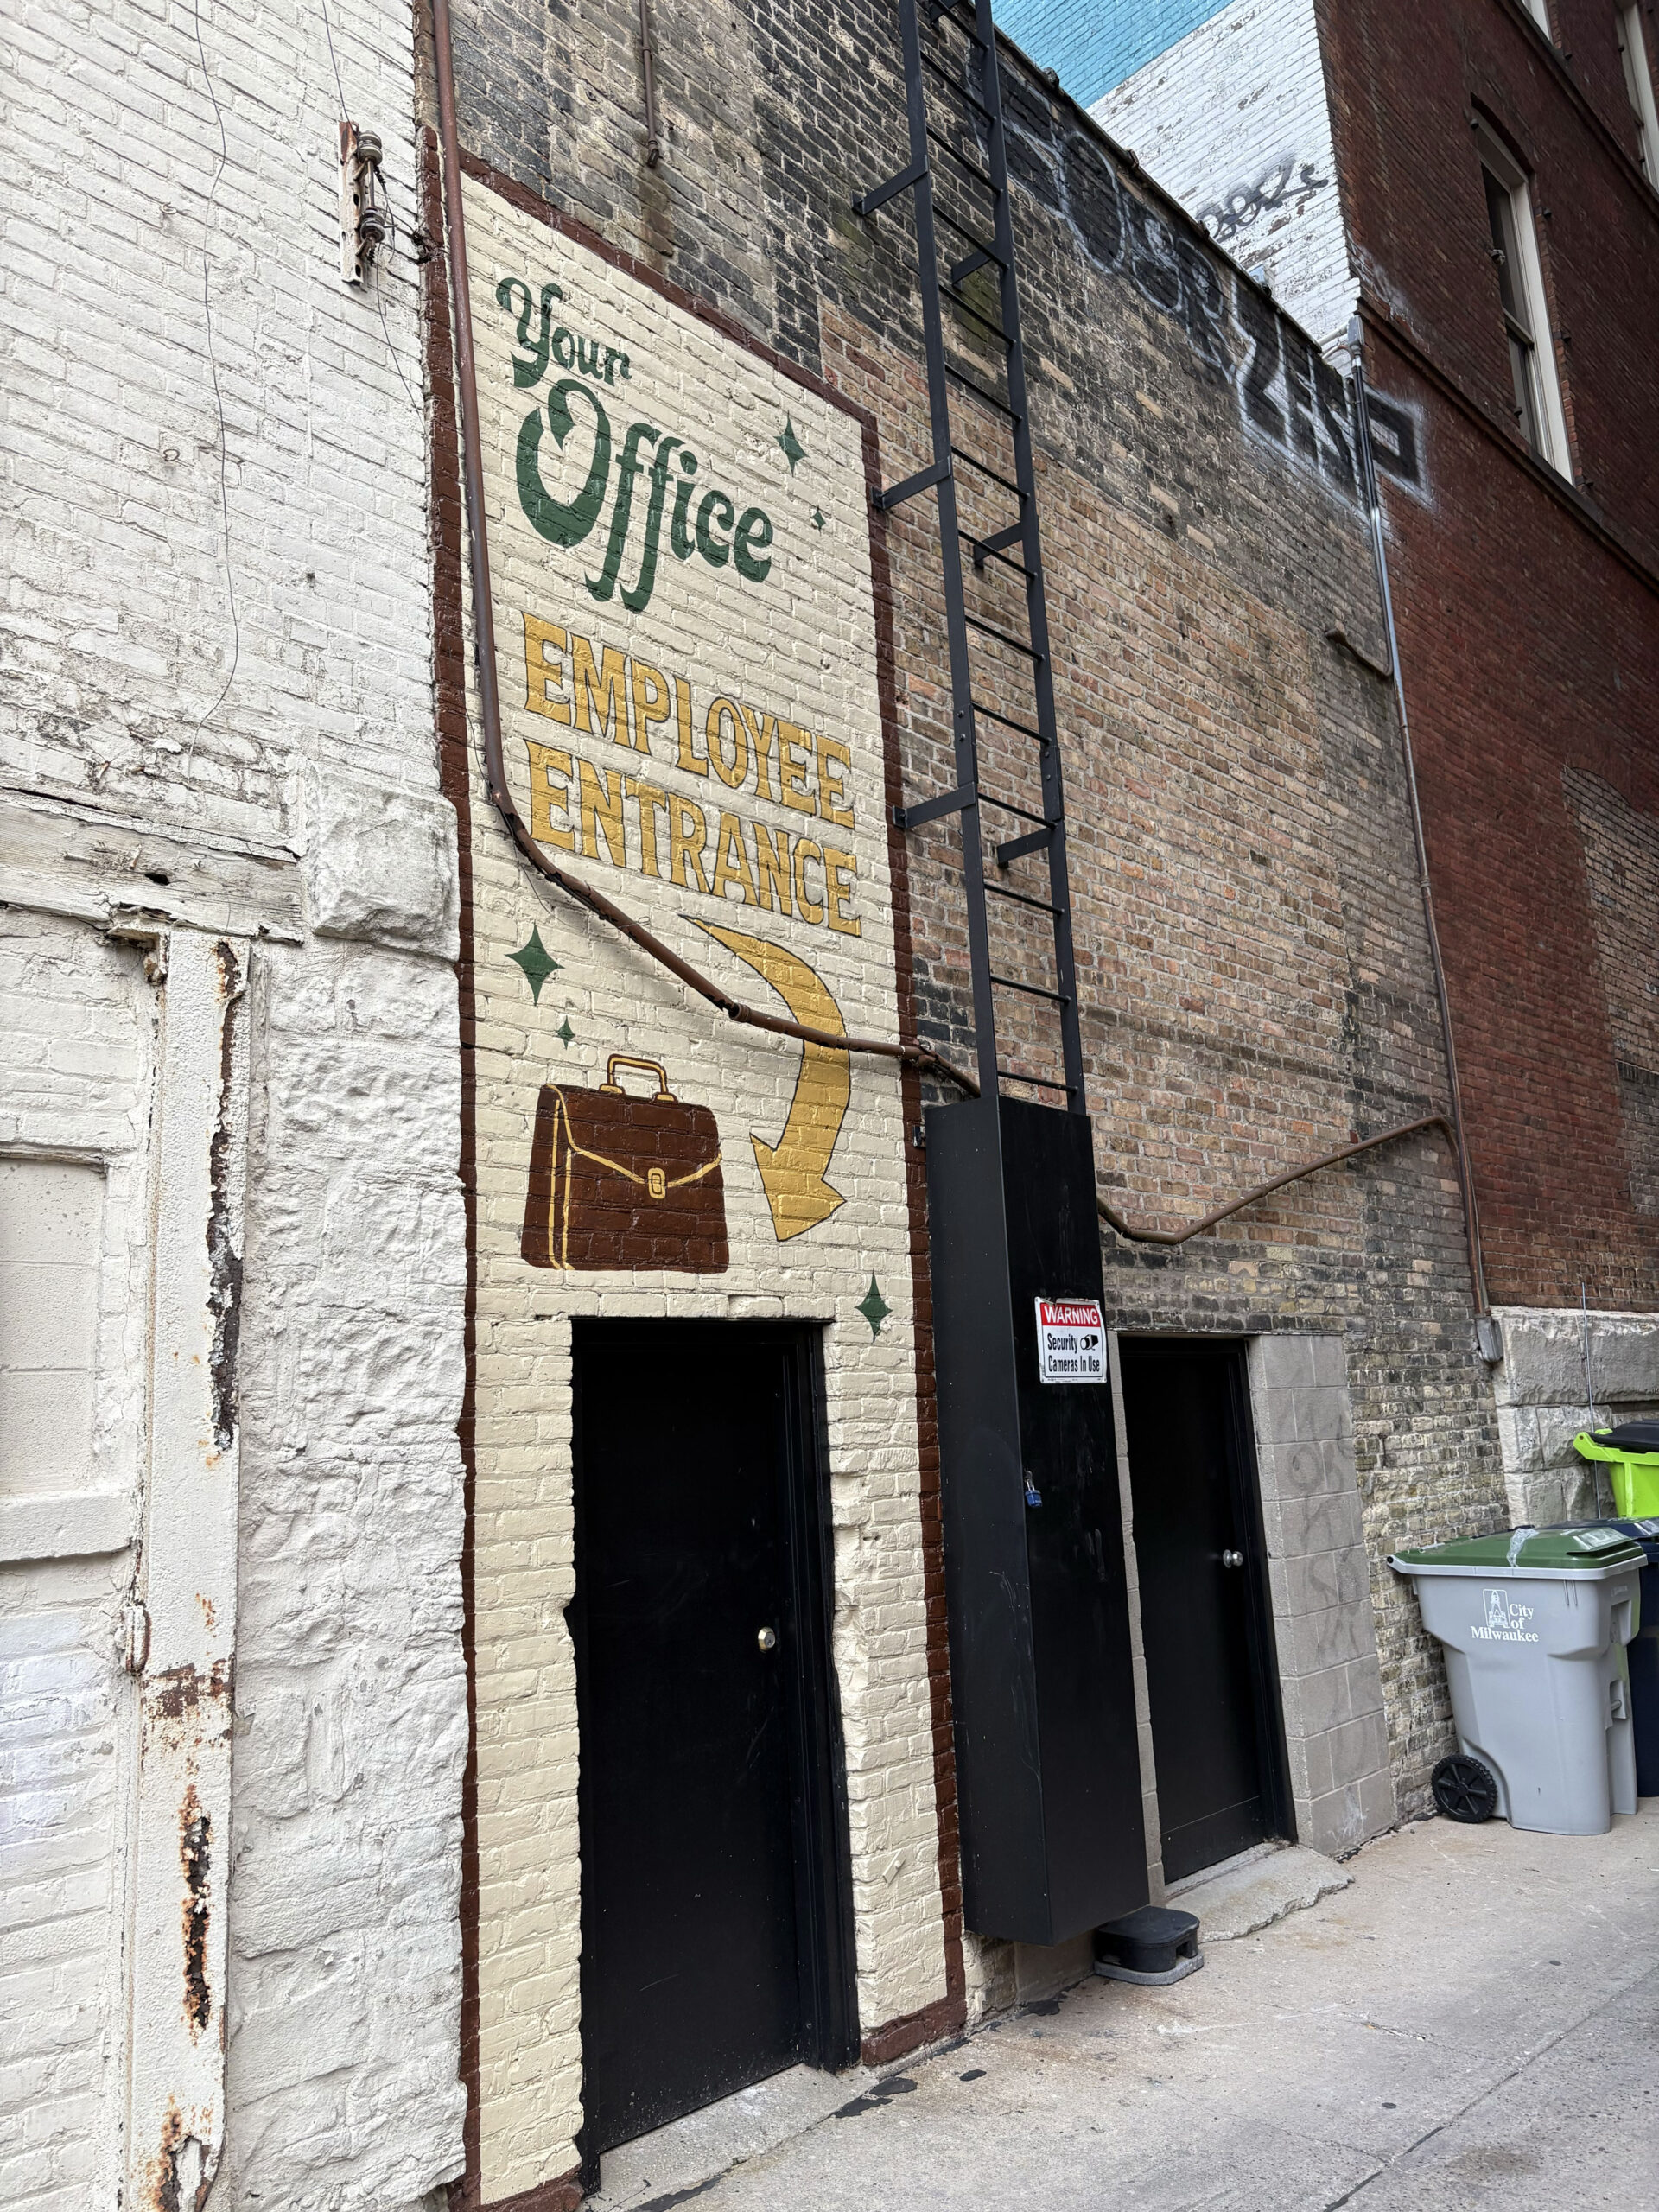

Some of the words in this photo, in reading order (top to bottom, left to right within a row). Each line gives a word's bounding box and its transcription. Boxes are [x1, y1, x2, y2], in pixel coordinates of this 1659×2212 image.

[495, 276, 633, 388] Your
[516, 379, 773, 614] Office
[521, 611, 855, 830] EMPLOYEE
[523, 738, 862, 938] ENTRANCE
[1044, 1306, 1098, 1325] WARNING
[1047, 1333, 1078, 1354] Security
[1048, 1355, 1078, 1372] Cameras
[1080, 1355, 1087, 1372] In
[1088, 1355, 1100, 1372] Use
[1509, 1603, 1534, 1620] City
[1471, 1625, 1539, 1642] Milwaukee
[1510, 1617, 1526, 1630] of
